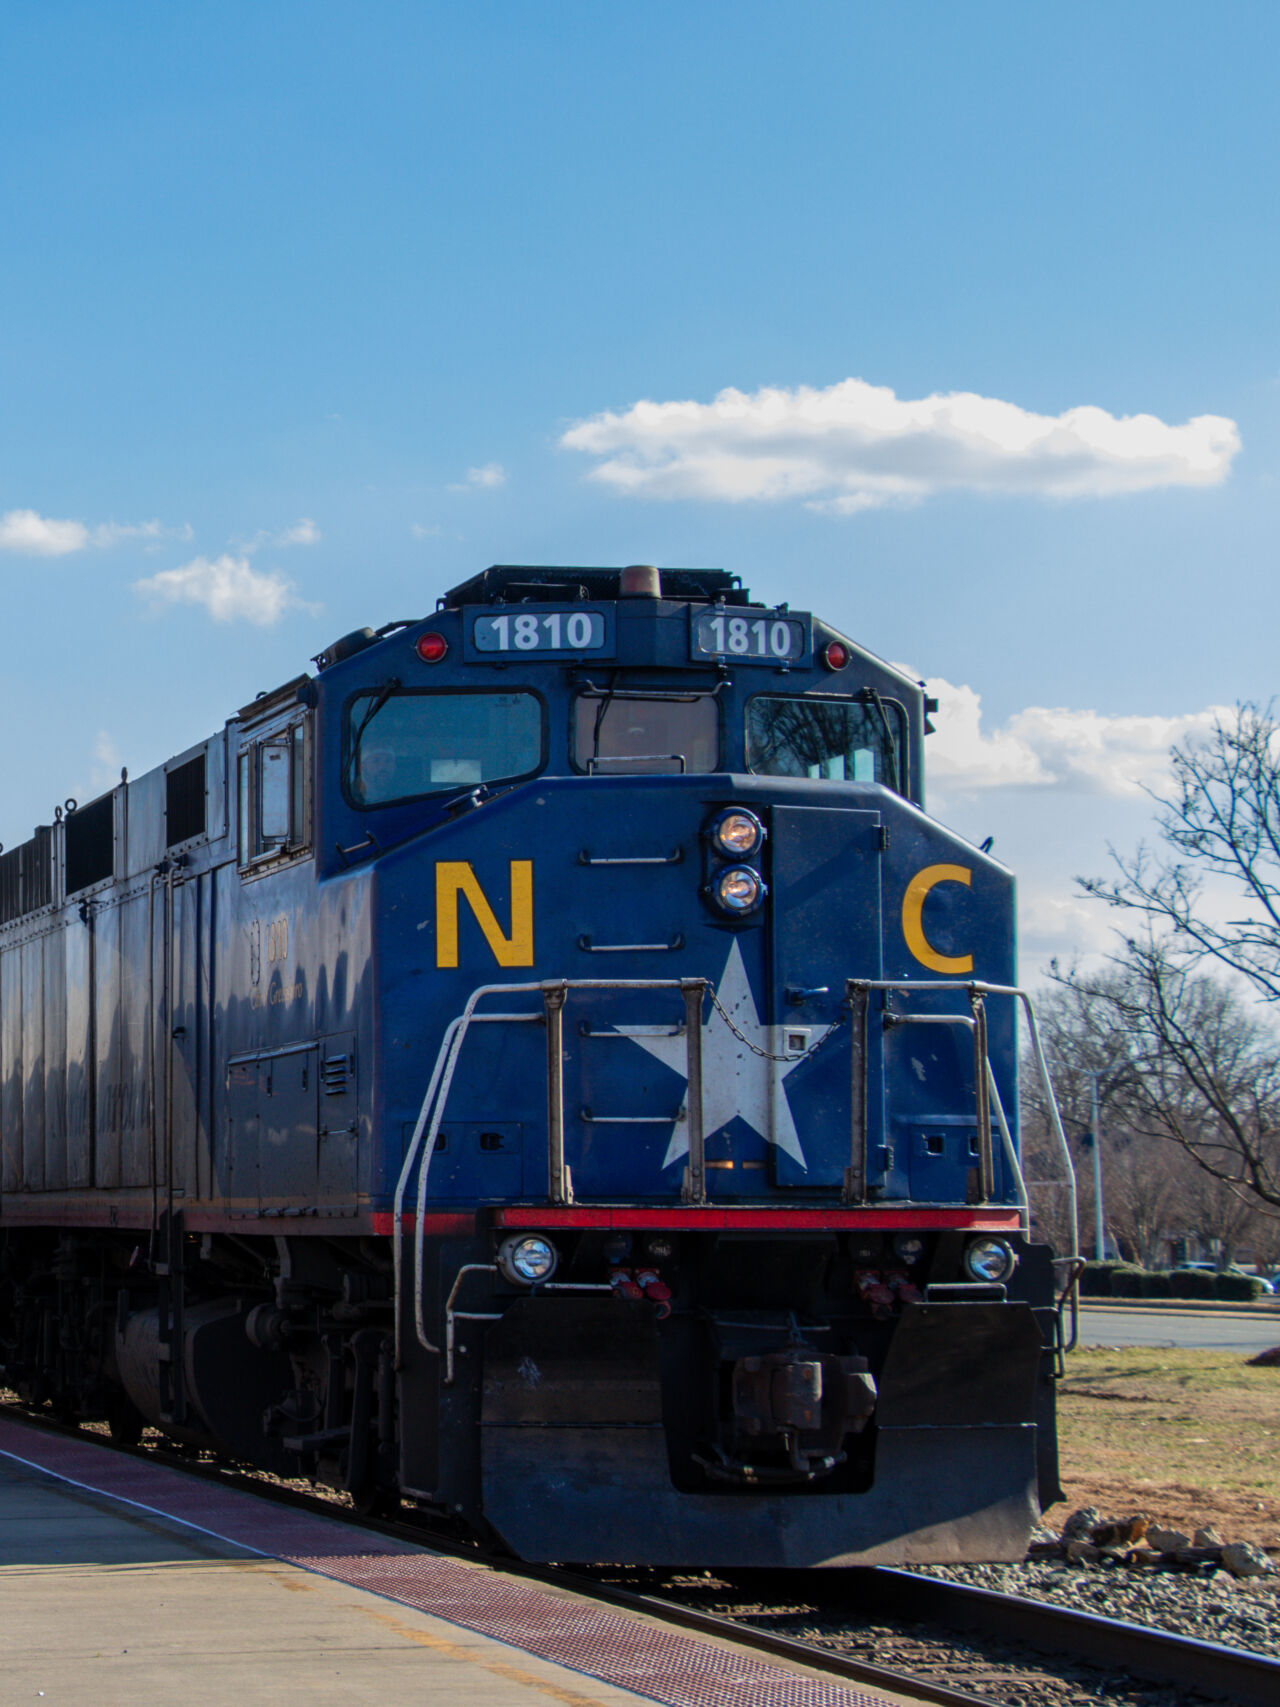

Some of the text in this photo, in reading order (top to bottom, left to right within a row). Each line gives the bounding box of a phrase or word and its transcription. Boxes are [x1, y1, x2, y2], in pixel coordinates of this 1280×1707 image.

[490, 612, 593, 651] 1810
[709, 616, 791, 657] 1810
[435, 860, 974, 974] N C
